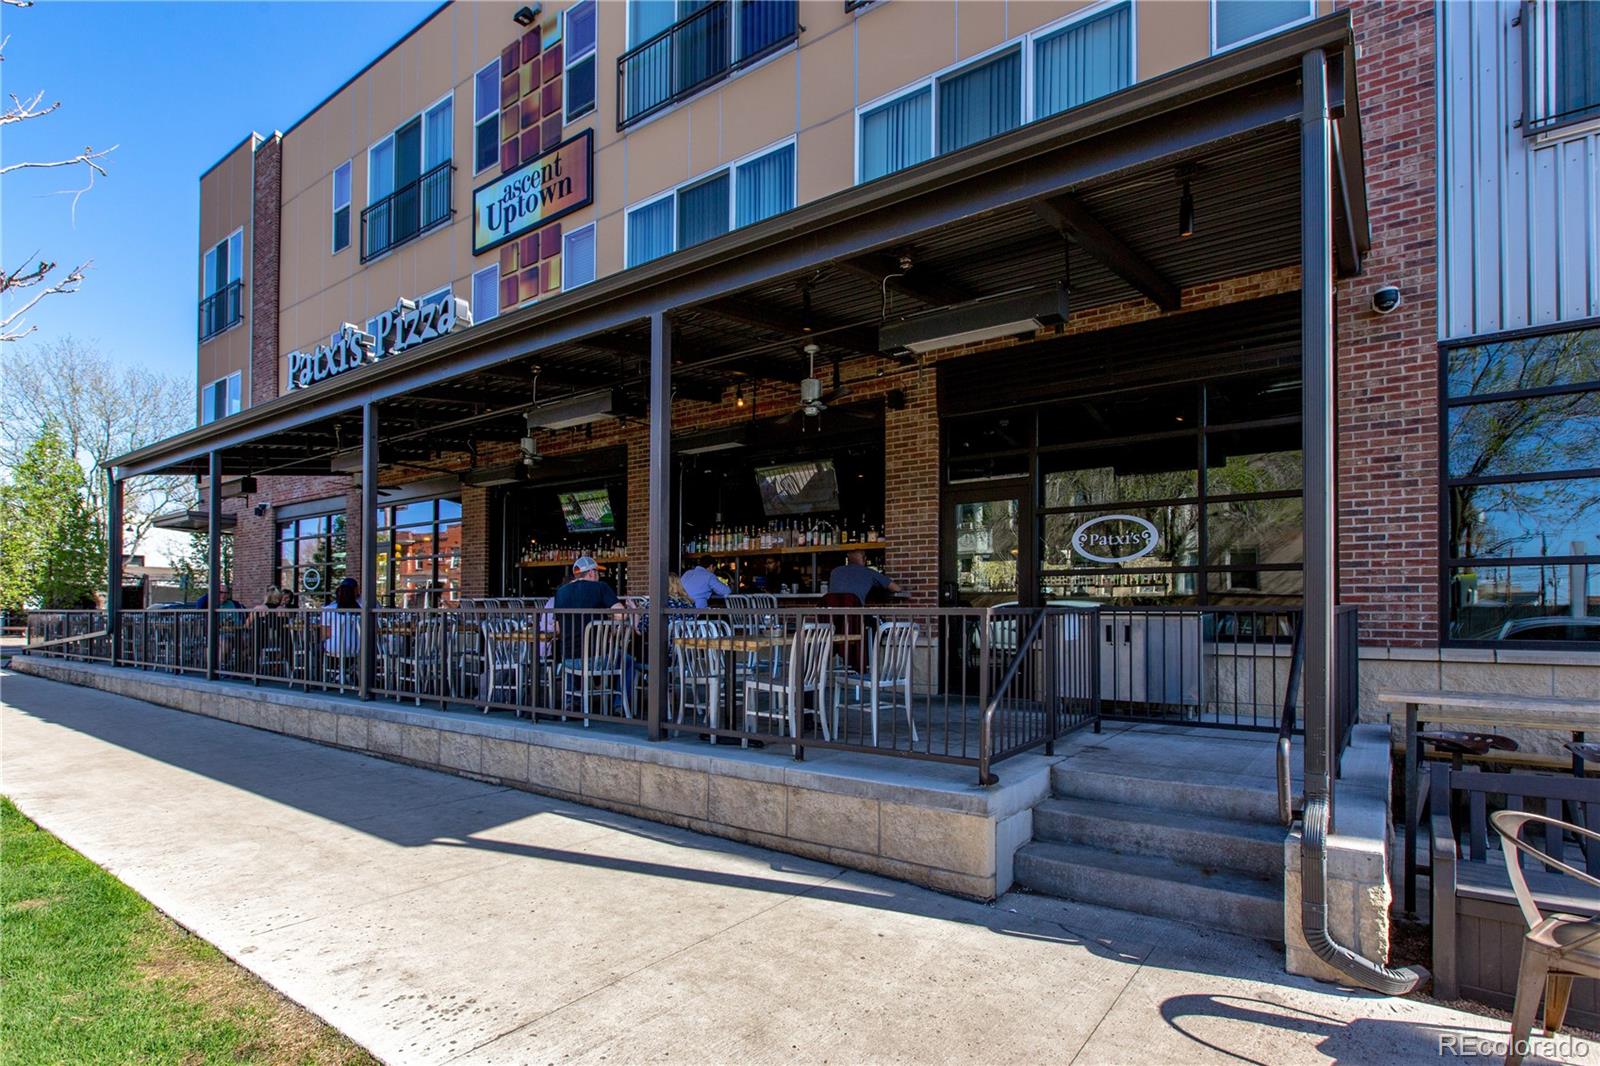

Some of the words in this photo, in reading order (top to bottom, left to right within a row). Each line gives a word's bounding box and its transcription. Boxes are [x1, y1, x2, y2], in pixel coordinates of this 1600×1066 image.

[486, 174, 573, 236] Uptown
[502, 151, 563, 203] ascent
[287, 320, 364, 391] Patxi's
[375, 294, 457, 358] Pizza
[1089, 530, 1140, 547] Patxi's
